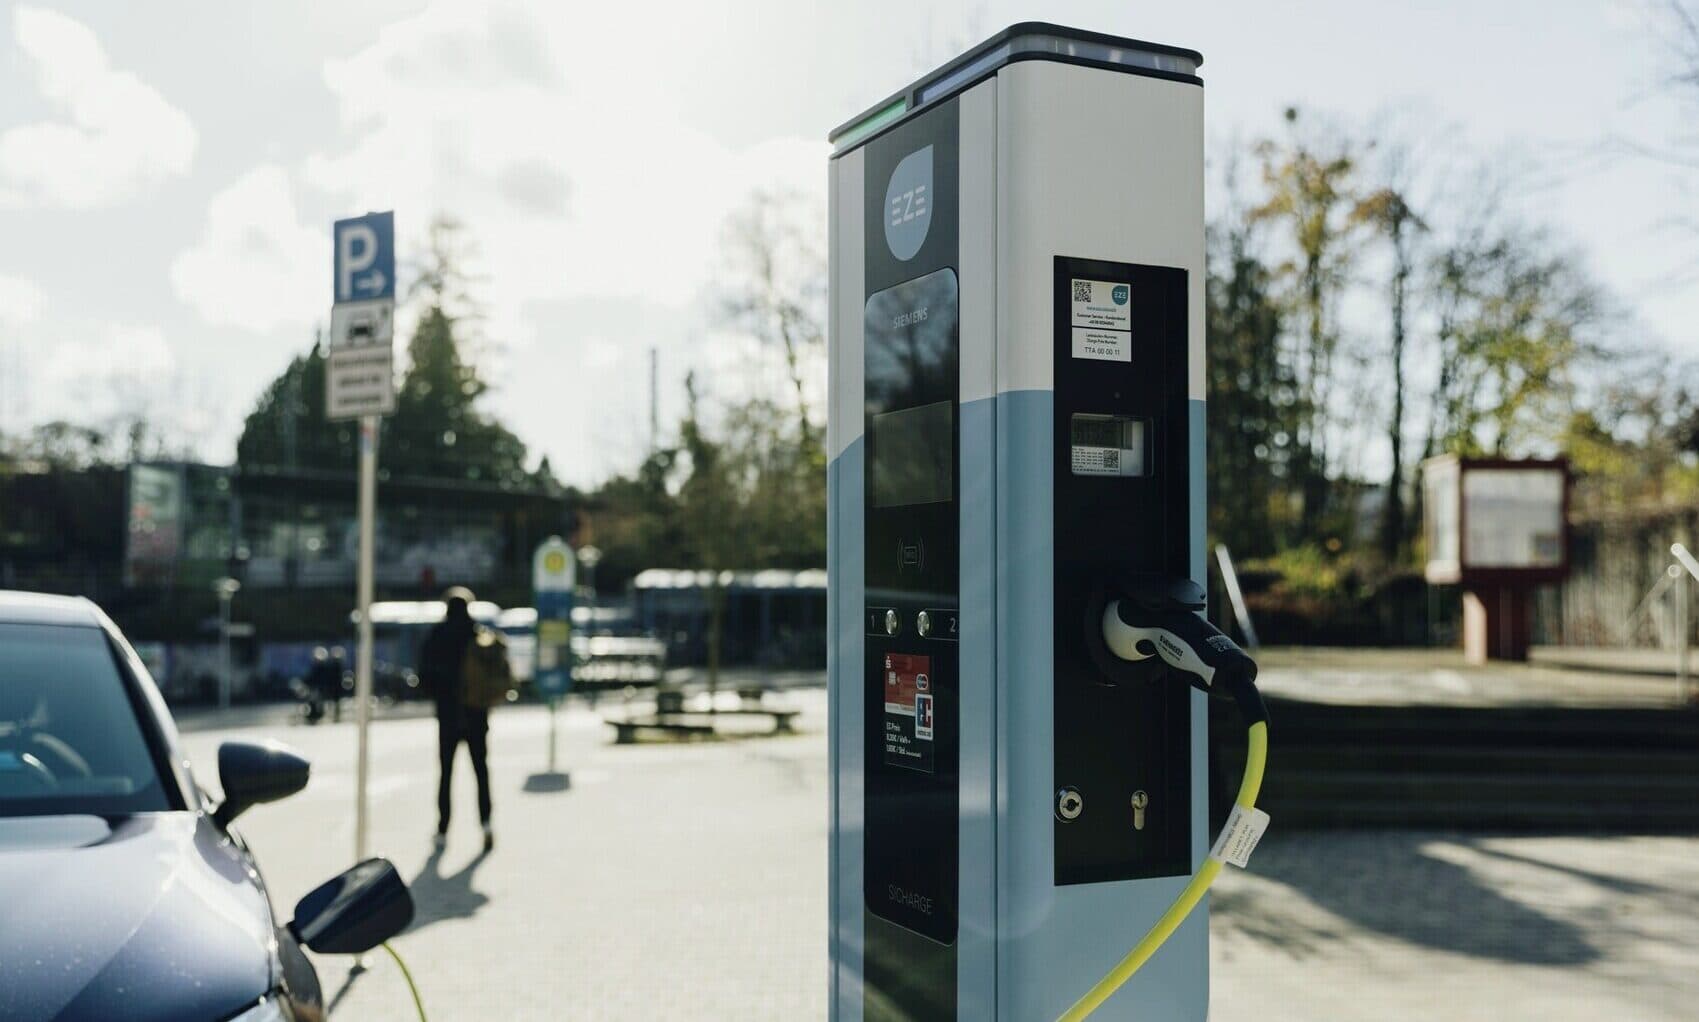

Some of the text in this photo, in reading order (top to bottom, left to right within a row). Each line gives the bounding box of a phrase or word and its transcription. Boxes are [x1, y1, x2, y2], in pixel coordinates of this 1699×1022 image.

[891, 185, 927, 226] EZE
[339, 223, 378, 301] P
[1113, 291, 1127, 299] EZE
[893, 307, 929, 329] SIEMENS
[870, 614, 876, 630] 1
[949, 617, 957, 633] 2
[888, 884, 934, 915] SICHARGE
